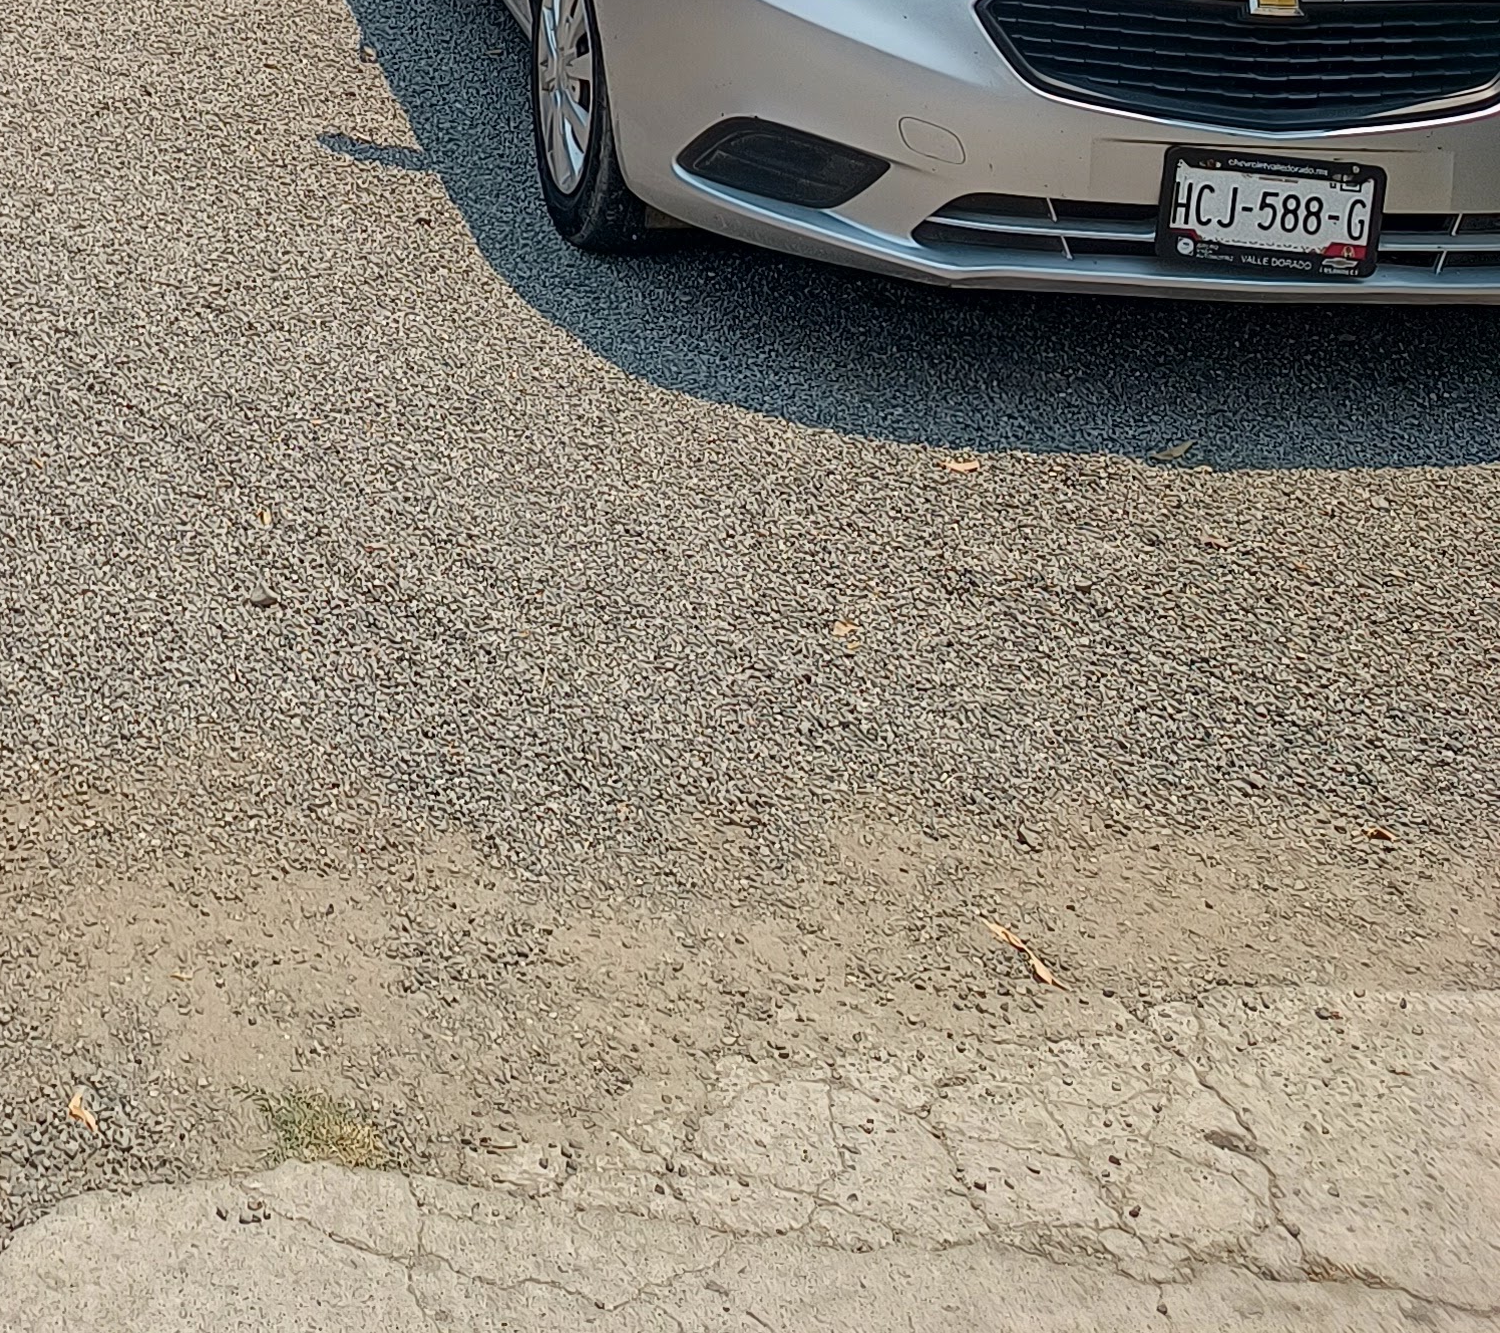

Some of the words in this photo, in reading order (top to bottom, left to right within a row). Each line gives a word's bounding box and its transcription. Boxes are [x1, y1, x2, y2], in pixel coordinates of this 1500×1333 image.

[1171, 181, 1367, 241] HCJ-588-G
[1240, 255, 1269, 265] VALLE
[1271, 257, 1312, 270] DORADO
